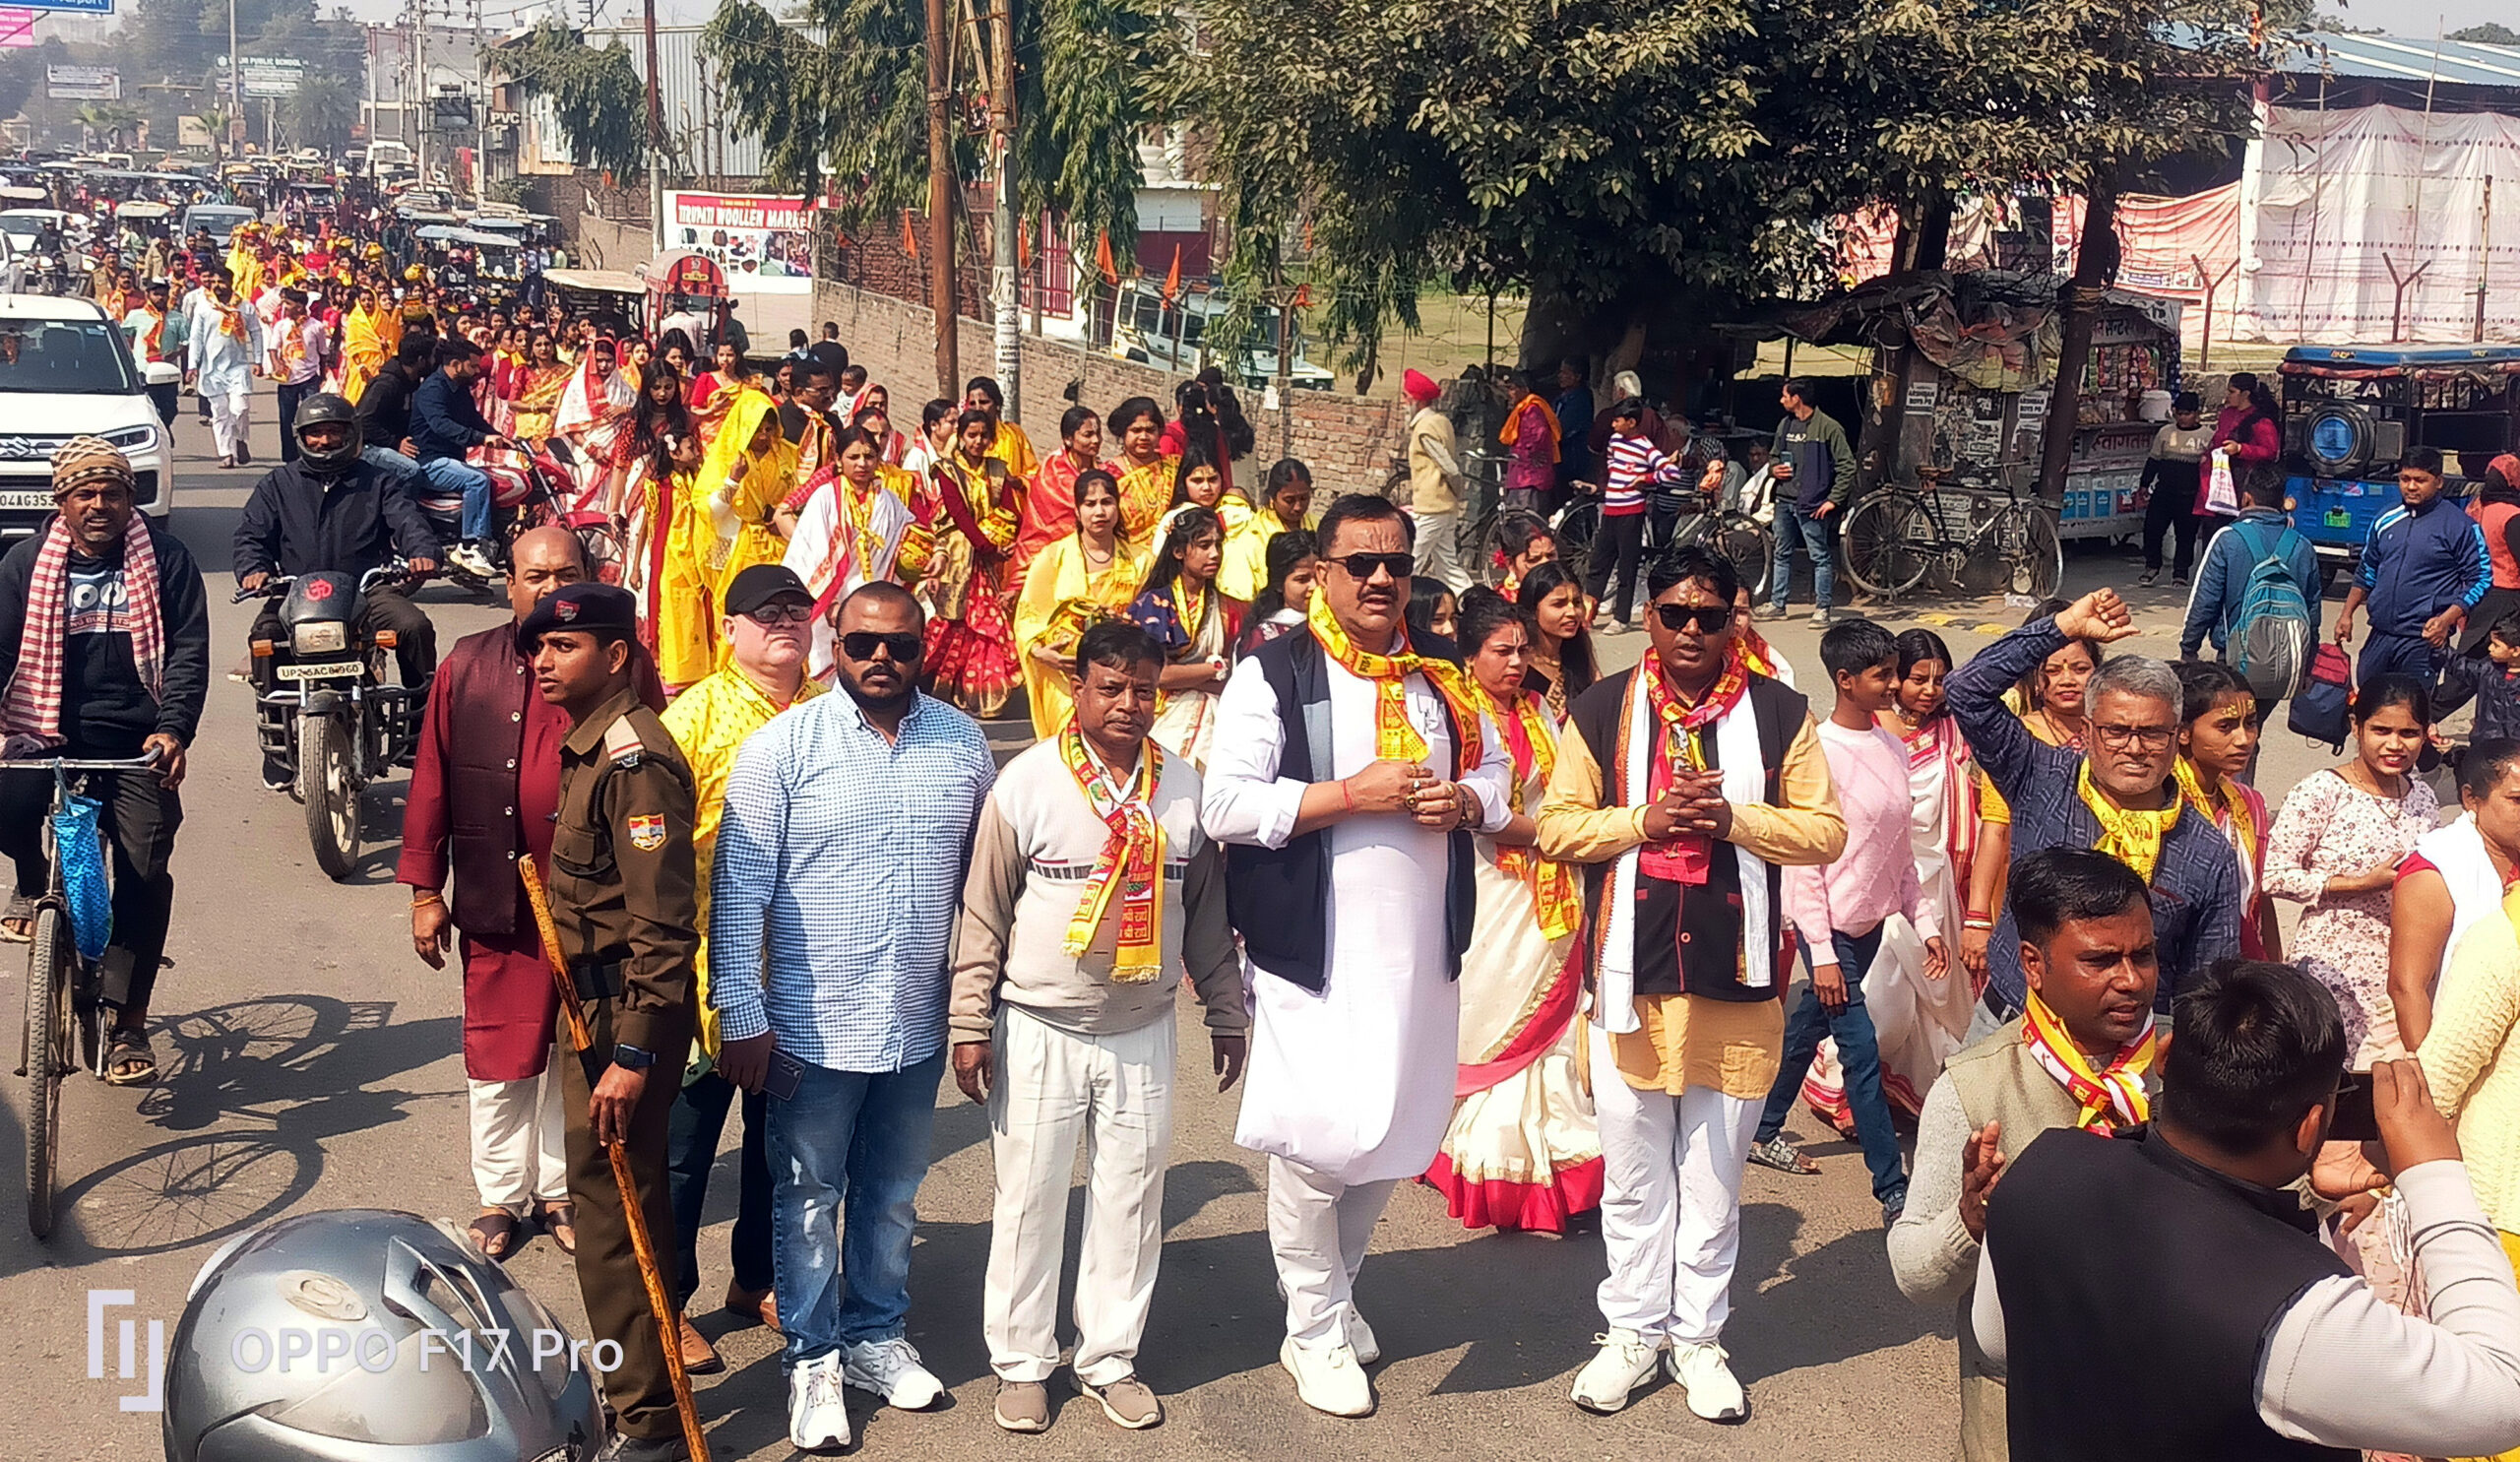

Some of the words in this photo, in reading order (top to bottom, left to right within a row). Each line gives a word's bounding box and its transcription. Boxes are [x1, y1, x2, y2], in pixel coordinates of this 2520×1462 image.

[490, 111, 520, 124] PVC
[678, 205, 715, 224] TIRUPATI
[717, 206, 765, 227] WOOLLEN
[766, 210, 814, 229] MARKET
